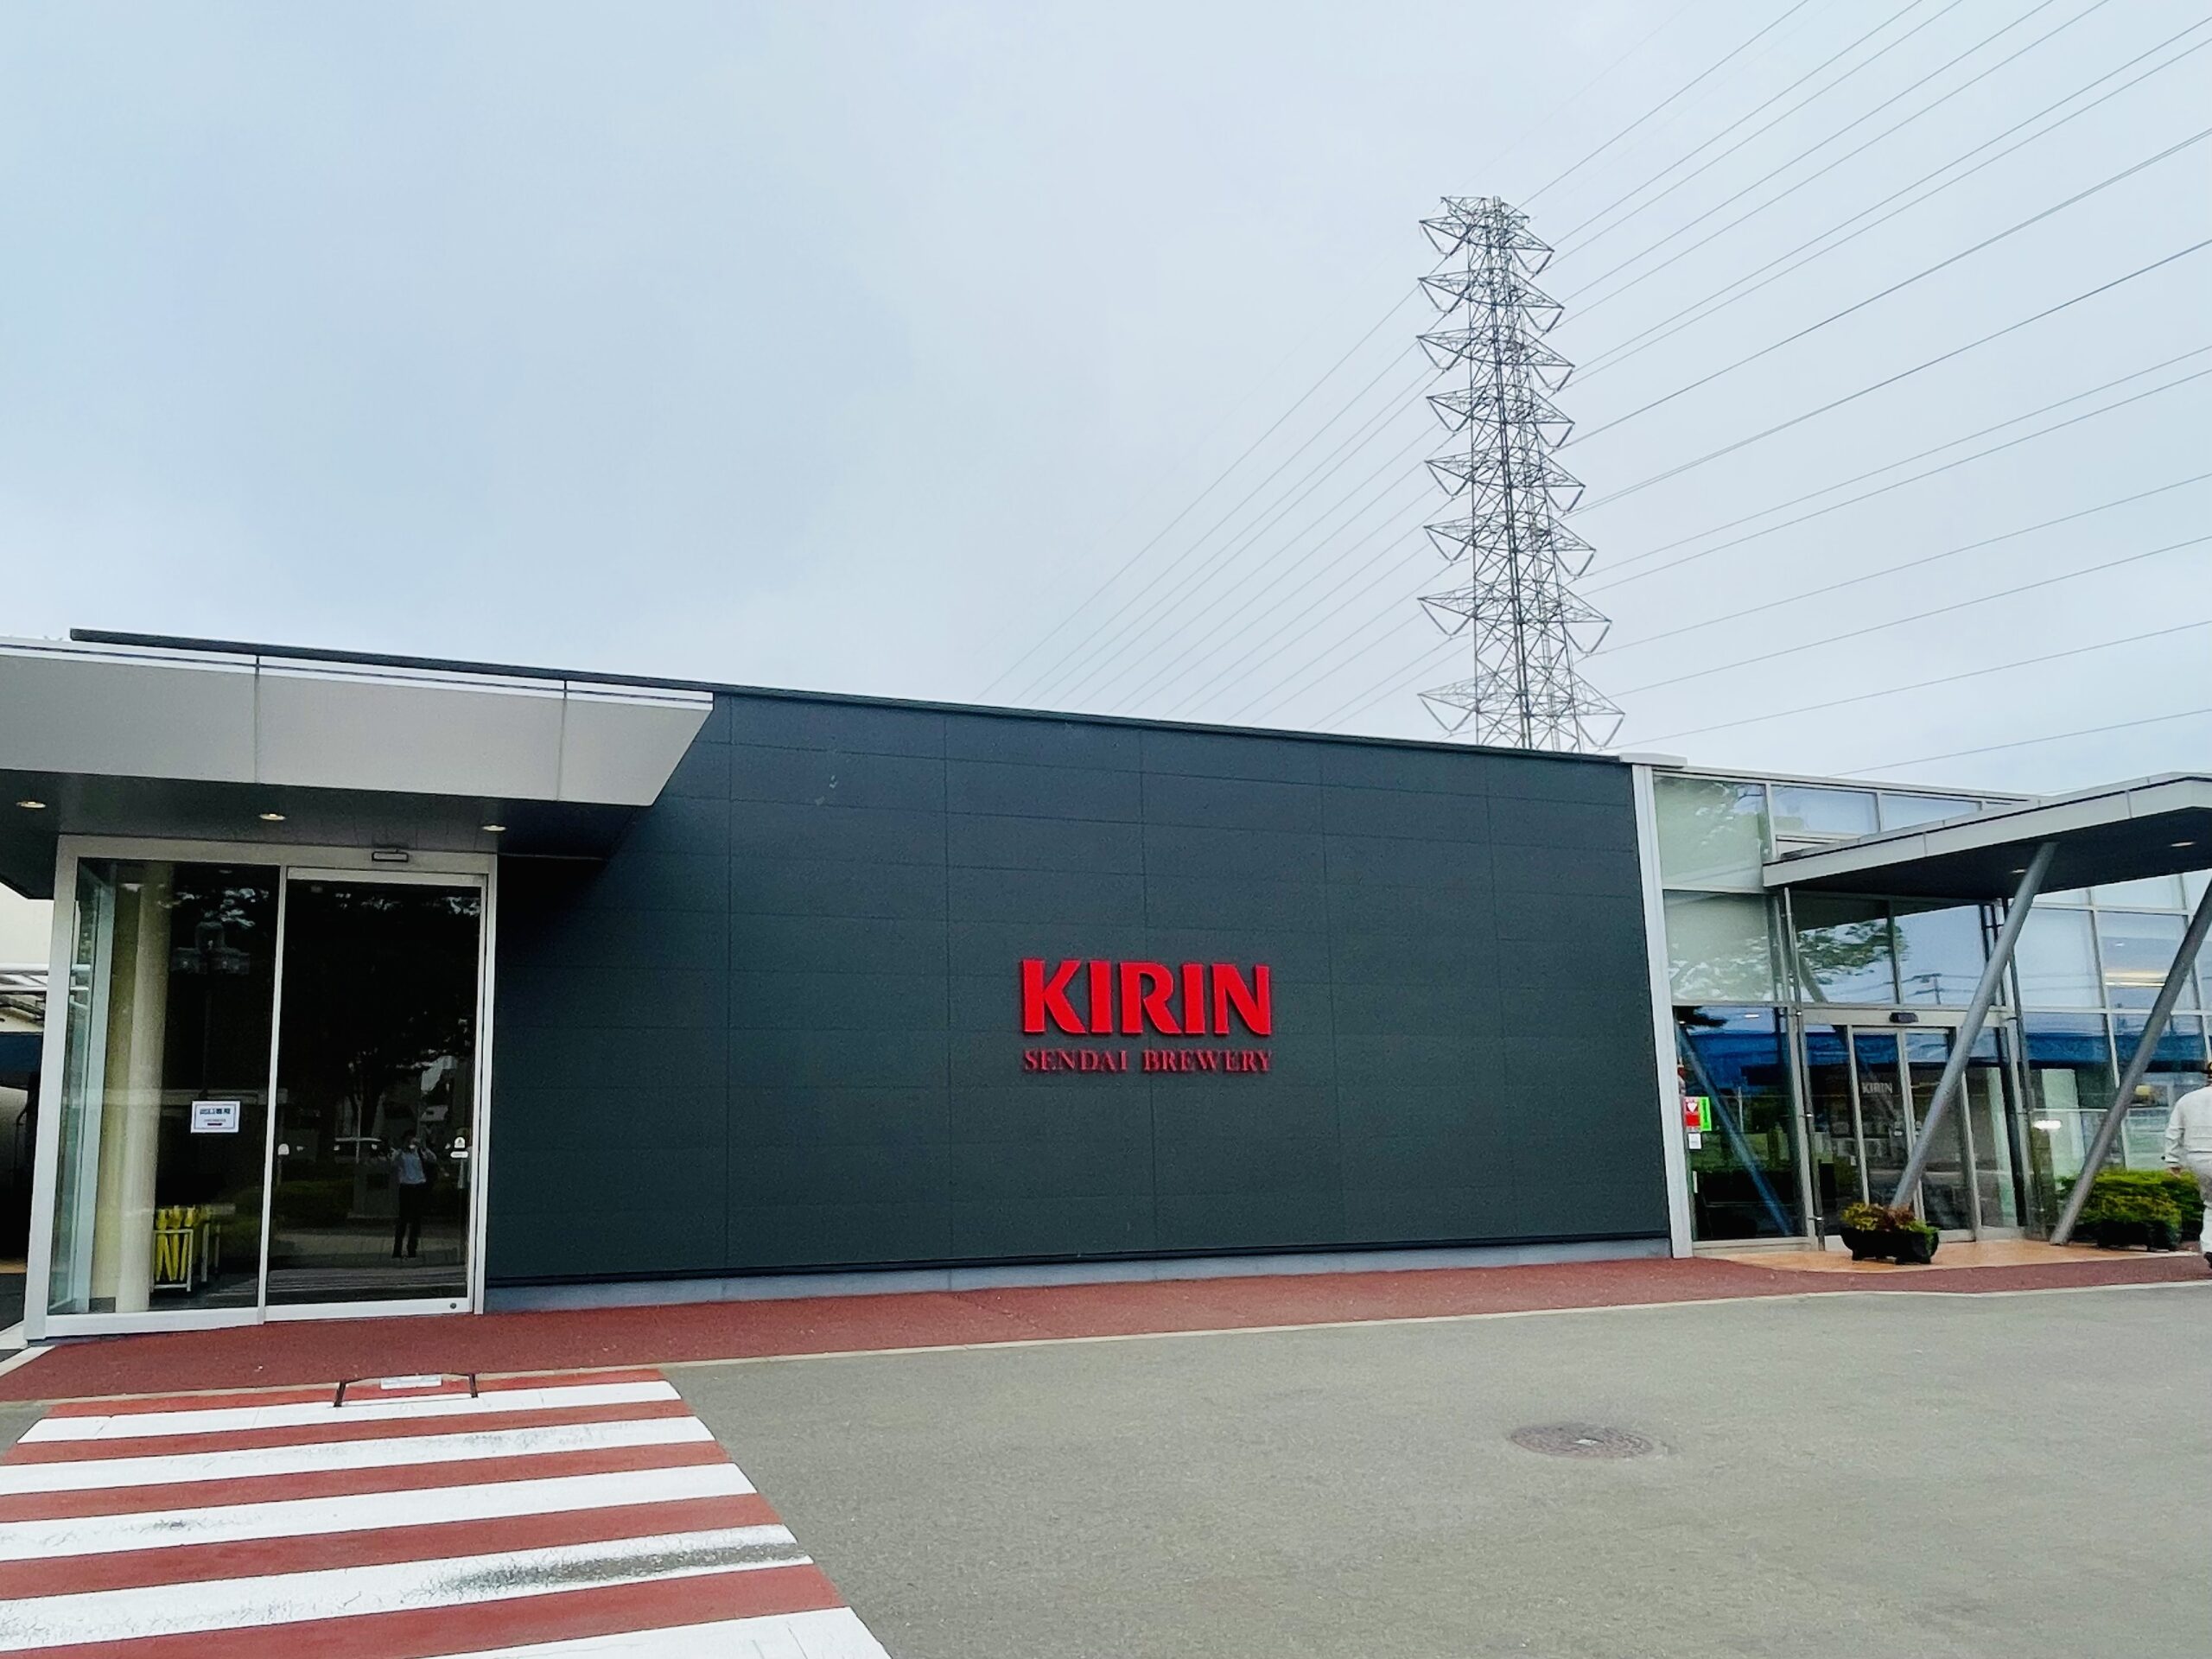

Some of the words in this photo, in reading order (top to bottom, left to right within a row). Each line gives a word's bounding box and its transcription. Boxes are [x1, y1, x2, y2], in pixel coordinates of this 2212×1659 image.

[1022, 959, 1272, 1035] KIRIN
[1023, 1049, 1128, 1072] SENDAI
[1142, 1049, 1272, 1072] BREWERY
[1861, 1082, 1893, 1094] KIRIN
